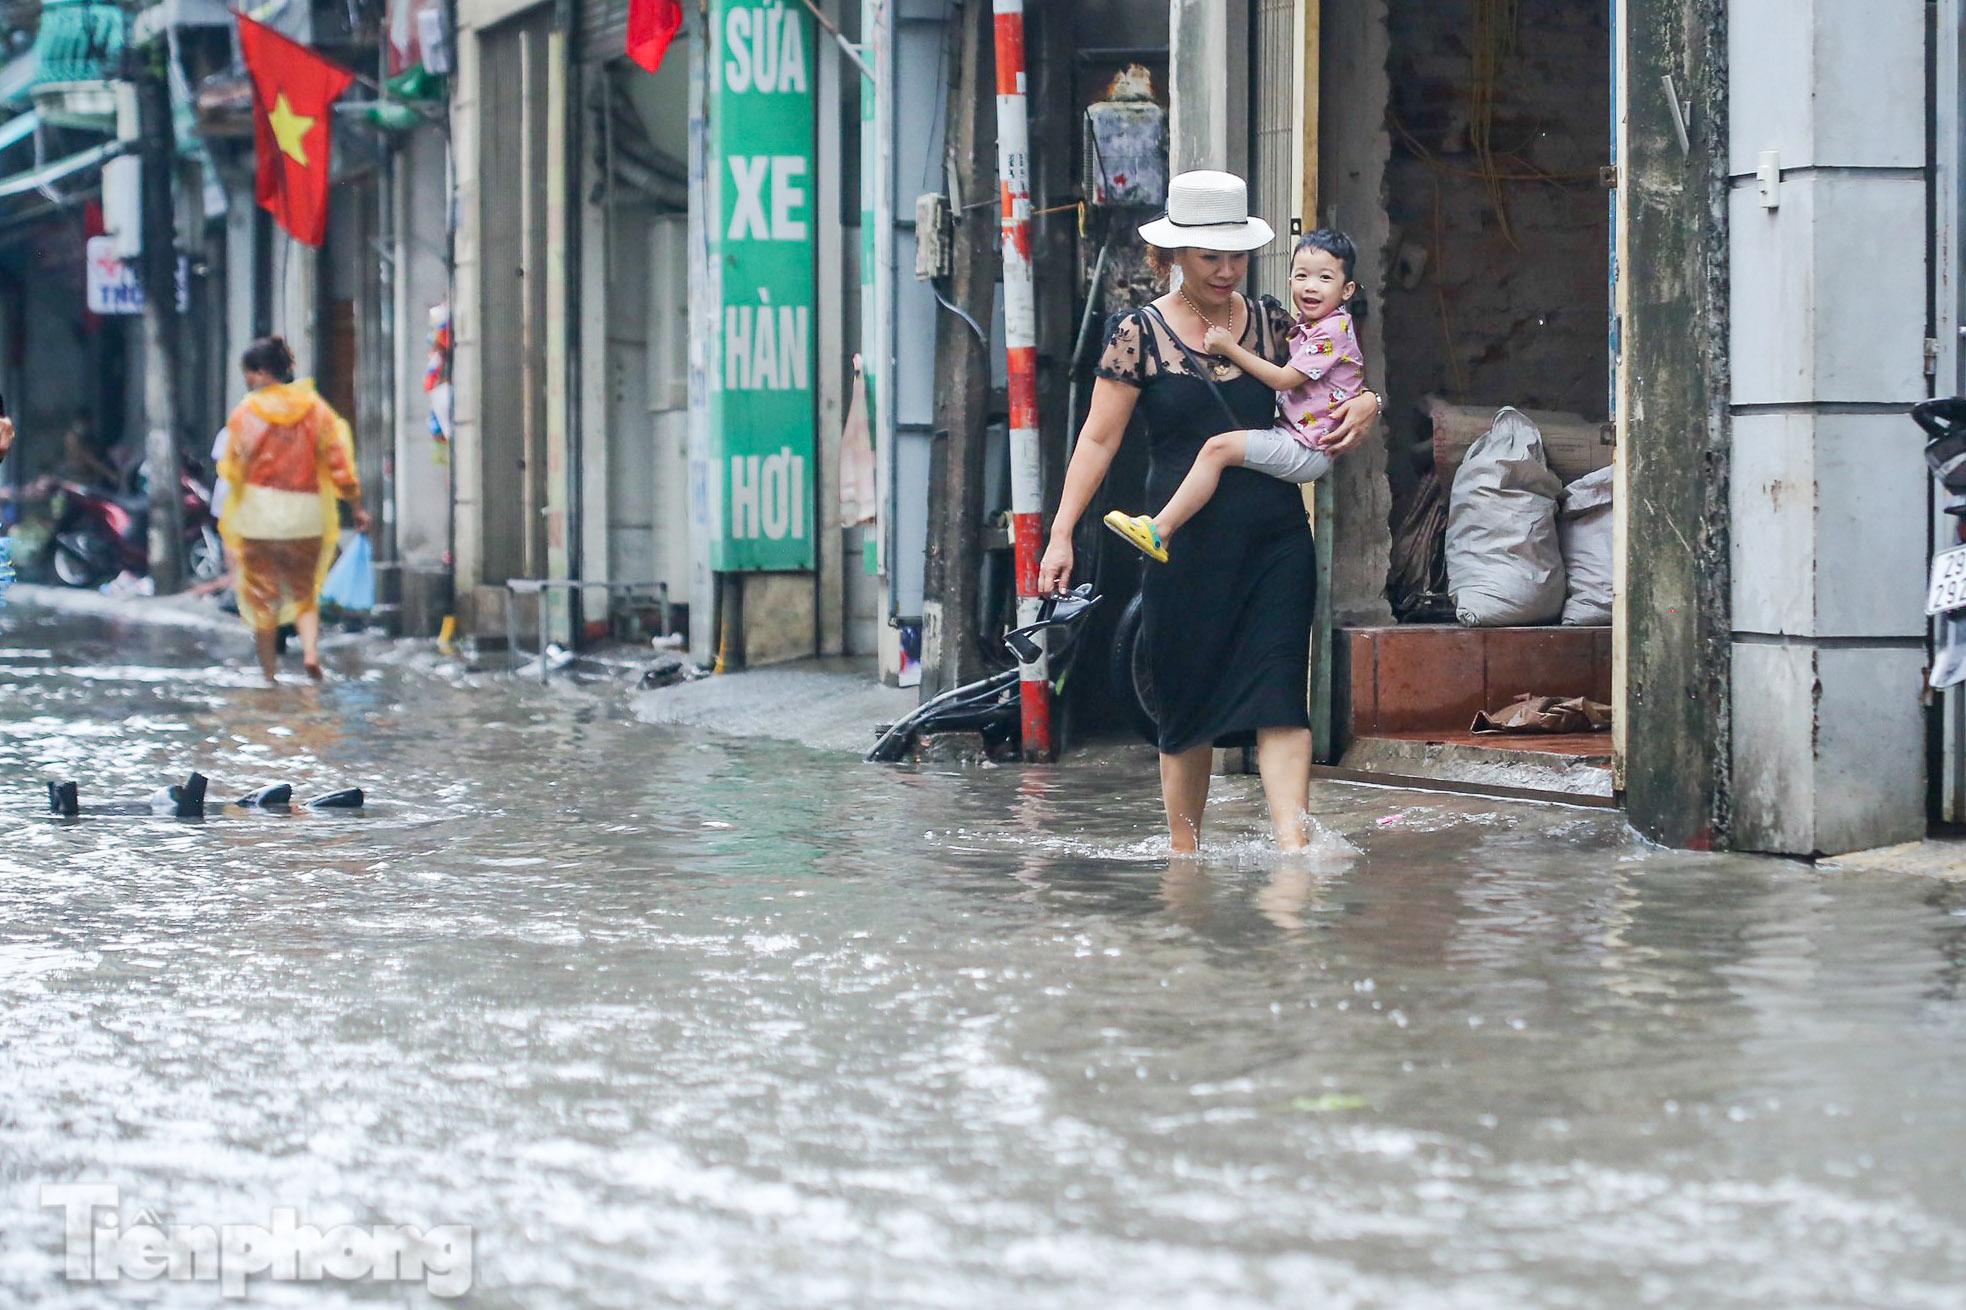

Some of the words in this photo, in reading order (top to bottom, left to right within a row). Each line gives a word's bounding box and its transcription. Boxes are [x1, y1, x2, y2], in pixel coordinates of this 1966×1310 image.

[727, 155, 806, 241] XE
[725, 287, 808, 390] HÀN
[731, 446, 806, 541] HƠI
